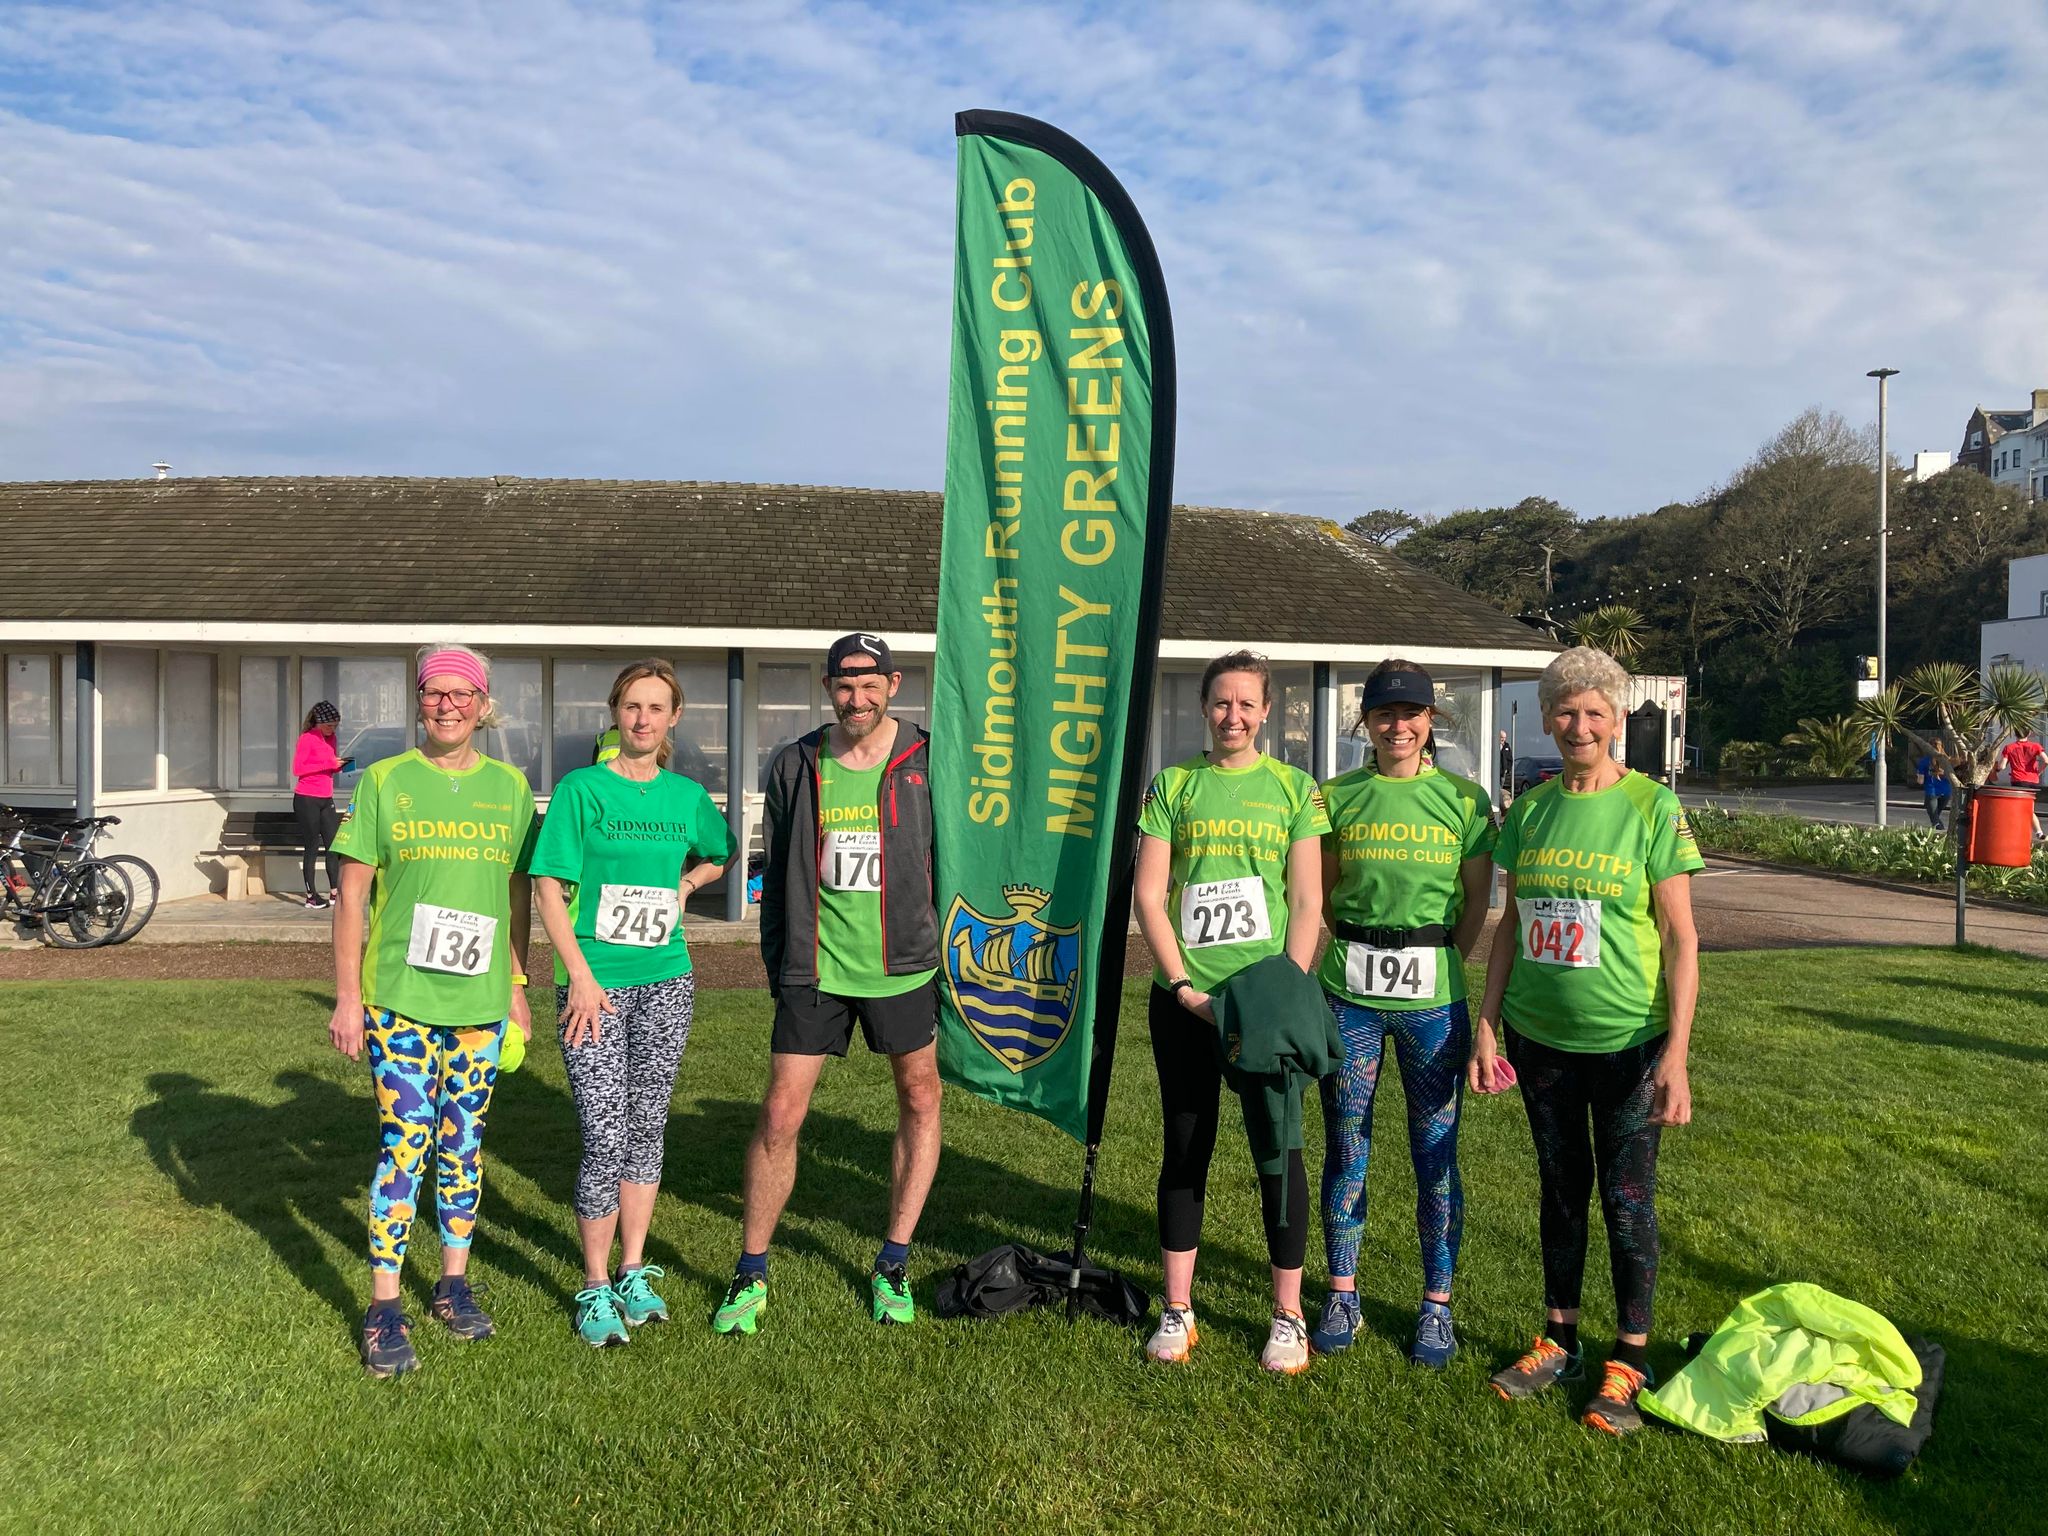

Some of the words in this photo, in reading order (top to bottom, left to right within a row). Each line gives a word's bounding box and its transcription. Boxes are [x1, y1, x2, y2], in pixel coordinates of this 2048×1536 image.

[991, 177, 1036, 312] Club
[1060, 277, 1124, 567] GREENS
[985, 329, 1042, 560] Running
[968, 577, 1019, 827] Sidmouth
[1046, 584, 1112, 839] MIGHTY
[606, 820, 687, 834] SIDMOUTH
[608, 832, 661, 842] RUNNING
[837, 834, 857, 844] LM
[1177, 819, 1289, 847] SIDMOUTH
[1340, 822, 1458, 847] SIDMOUTH
[399, 845, 479, 863] RUNNING
[1183, 843, 1244, 859] RUNNING
[1248, 846, 1279, 862] CLUB
[1342, 847, 1408, 861] RUNNING
[1414, 849, 1453, 864] CLUB
[1516, 847, 1633, 877] IDMOUTH
[834, 851, 882, 888] 170
[623, 887, 643, 898] LM
[1198, 885, 1218, 898] LM
[1574, 876, 1623, 898] CLUB
[437, 909, 459, 922] LM
[1534, 900, 1553, 911] LM
[609, 904, 669, 943] 245
[1193, 899, 1257, 944] 223
[425, 926, 481, 972] 136
[1528, 918, 1585, 963] 042
[1364, 953, 1422, 995] 194
